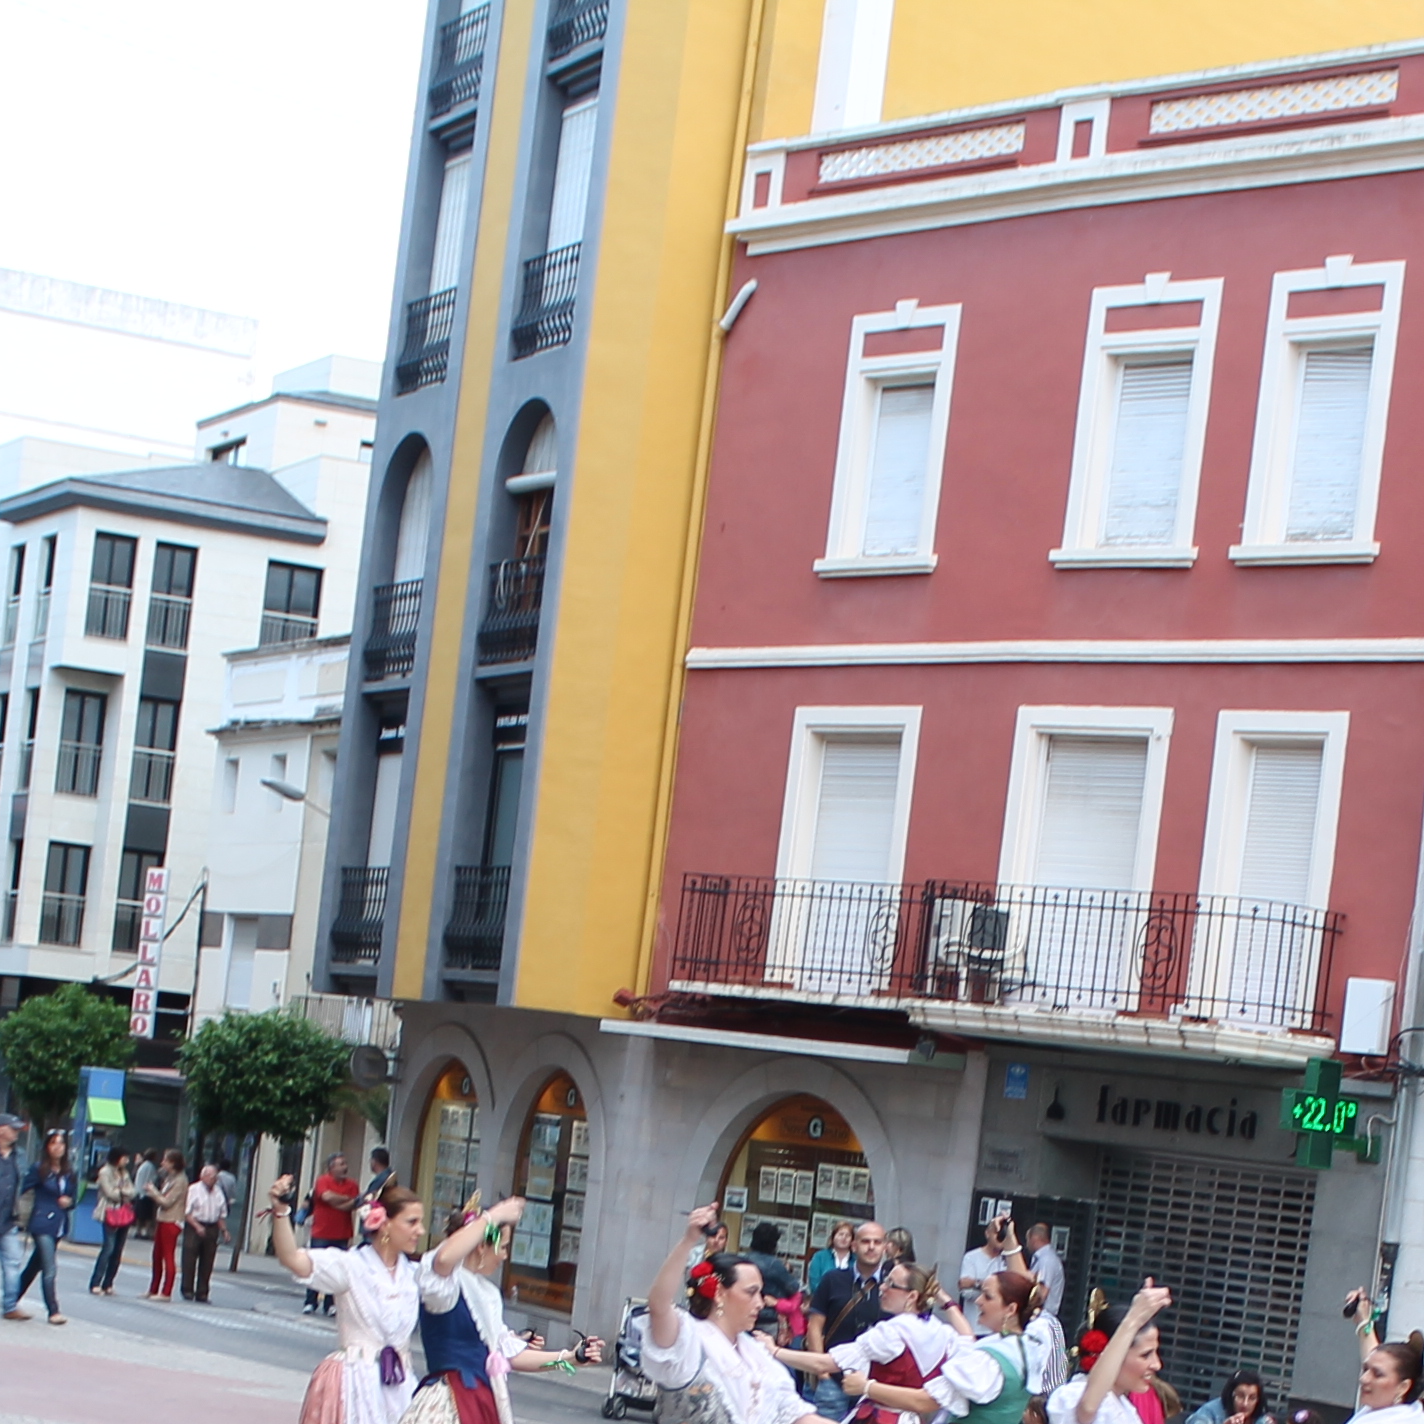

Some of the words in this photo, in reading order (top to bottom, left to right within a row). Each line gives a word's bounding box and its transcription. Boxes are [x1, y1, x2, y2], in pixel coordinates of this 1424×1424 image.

[131, 872, 164, 1035] MOLLARO
[809, 1117, 823, 1138] G
[1096, 1084, 1258, 1140] farmacia
